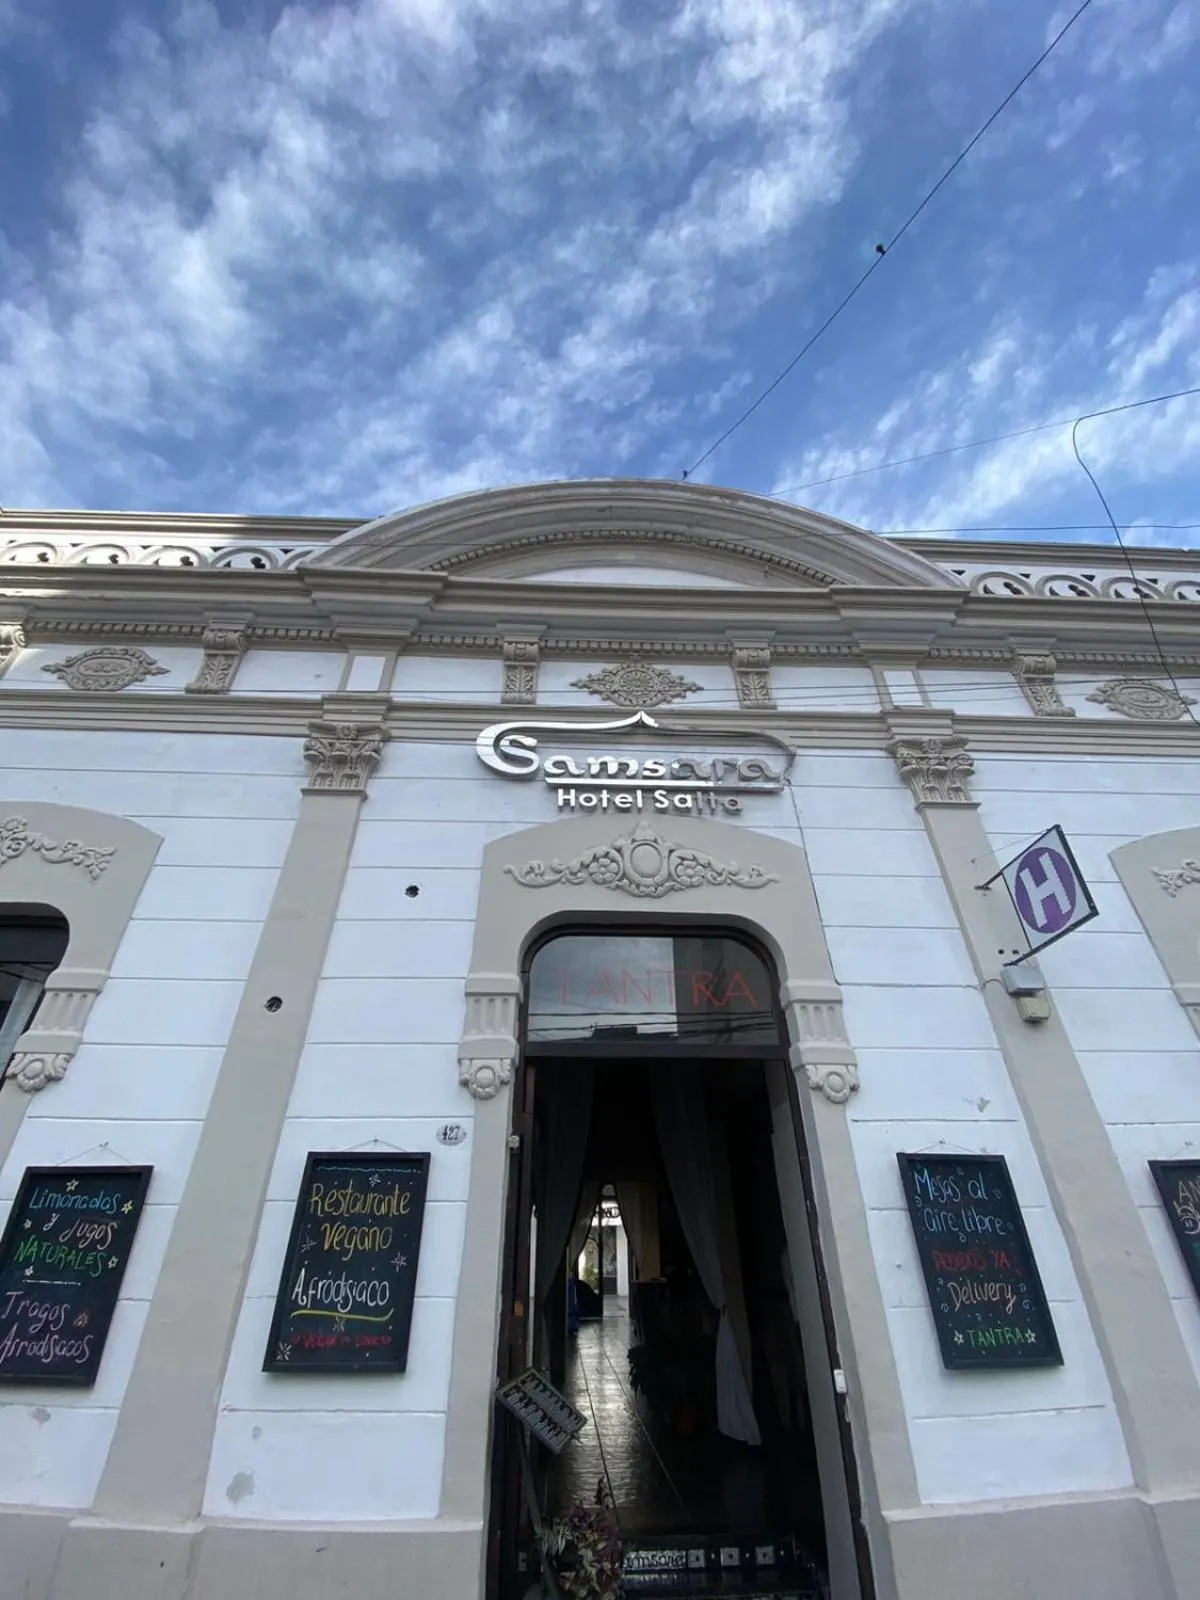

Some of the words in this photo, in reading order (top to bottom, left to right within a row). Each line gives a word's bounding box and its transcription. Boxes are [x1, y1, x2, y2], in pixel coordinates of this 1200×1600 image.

[476, 711, 791, 780] Samsara
[557, 788, 643, 810] Hotel
[654, 789, 743, 813] Salta
[1020, 852, 1072, 929] H
[551, 967, 760, 1009] TANTRA
[967, 1171, 988, 1200] al
[42, 1213, 60, 1231] y
[14, 1234, 107, 1278] NATURALES
[947, 1279, 1017, 1314] Delivery
[967, 1328, 1025, 1348] TANTRA
